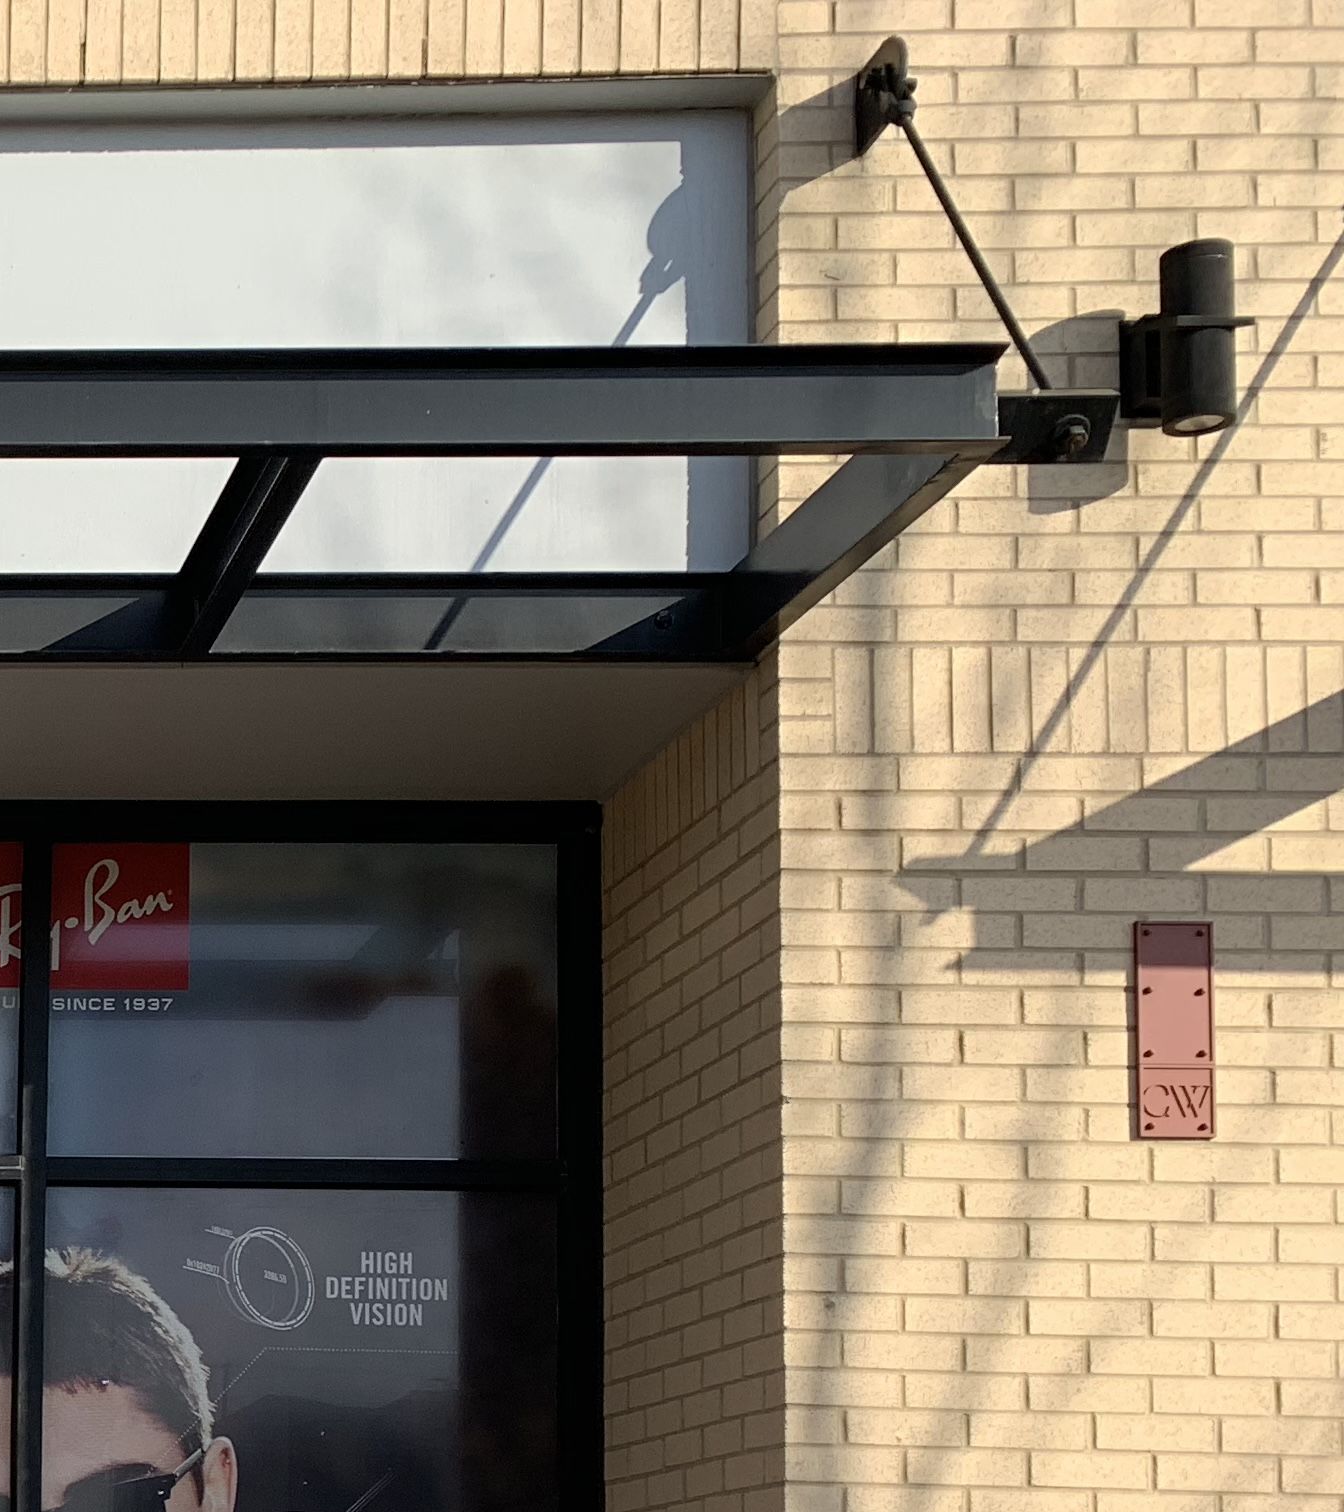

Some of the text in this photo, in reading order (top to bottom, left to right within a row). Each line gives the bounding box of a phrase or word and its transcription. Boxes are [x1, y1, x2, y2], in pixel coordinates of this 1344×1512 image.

[52, 997, 115, 1011] SINCE
[123, 998, 174, 1011] 1937
[360, 1251, 413, 1274] HIGH
[325, 1276, 448, 1301] DEFINITION
[350, 1302, 423, 1326] VISION
